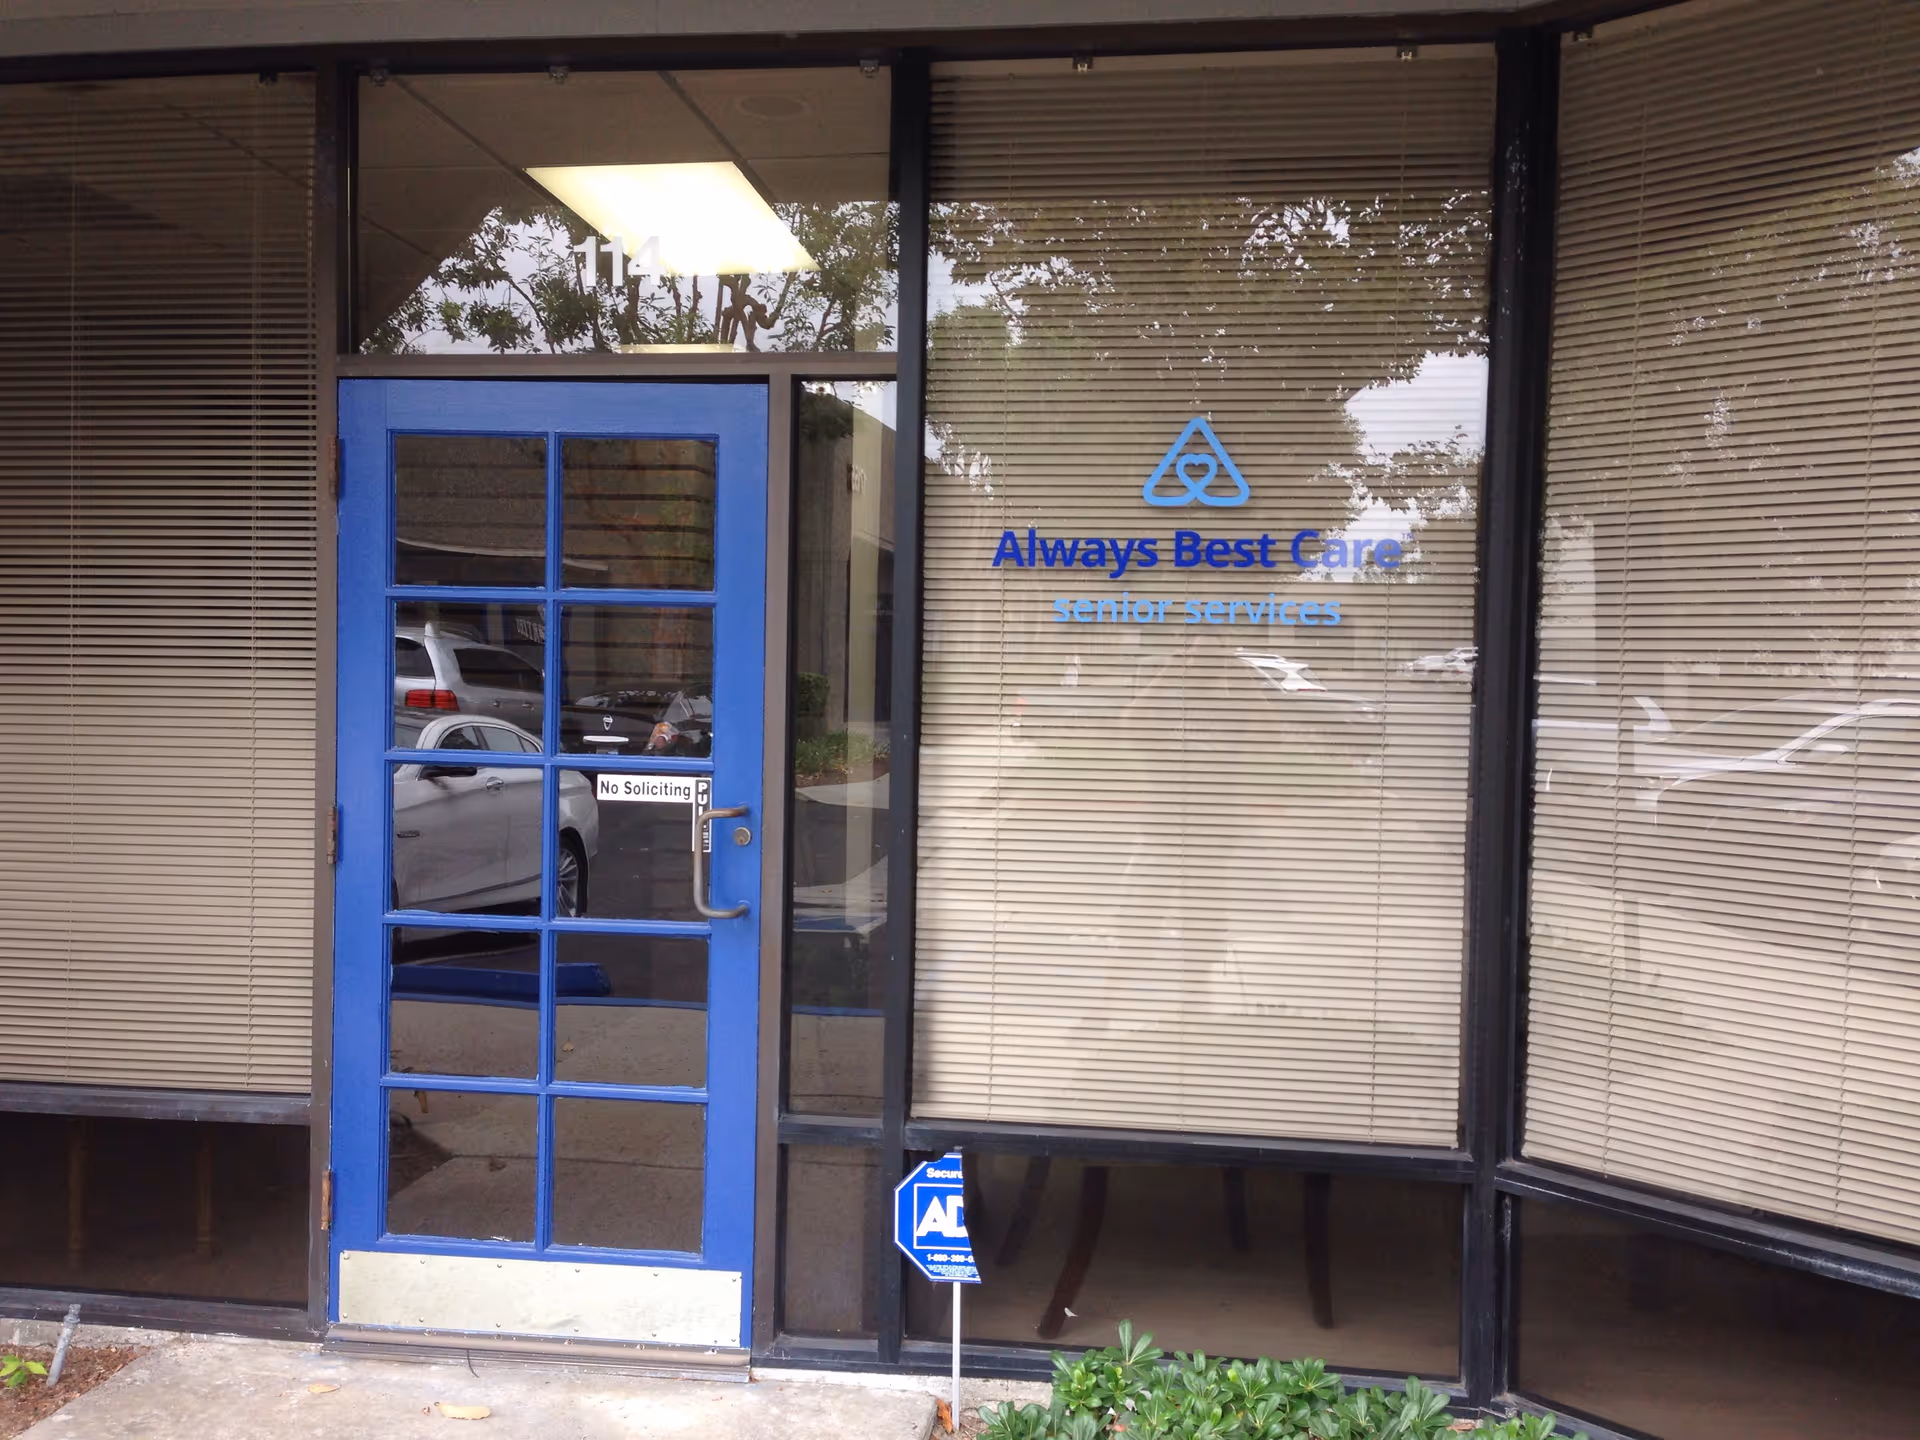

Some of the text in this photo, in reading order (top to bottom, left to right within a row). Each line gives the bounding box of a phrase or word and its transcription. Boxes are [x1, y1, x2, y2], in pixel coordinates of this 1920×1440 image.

[574, 235, 665, 286] 114
[992, 529, 1158, 578] Always
[1174, 531, 1277, 568] Best
[1292, 530, 1401, 568] Care
[1053, 592, 1342, 625] senior services
[600, 781, 691, 800] No Soliciting
